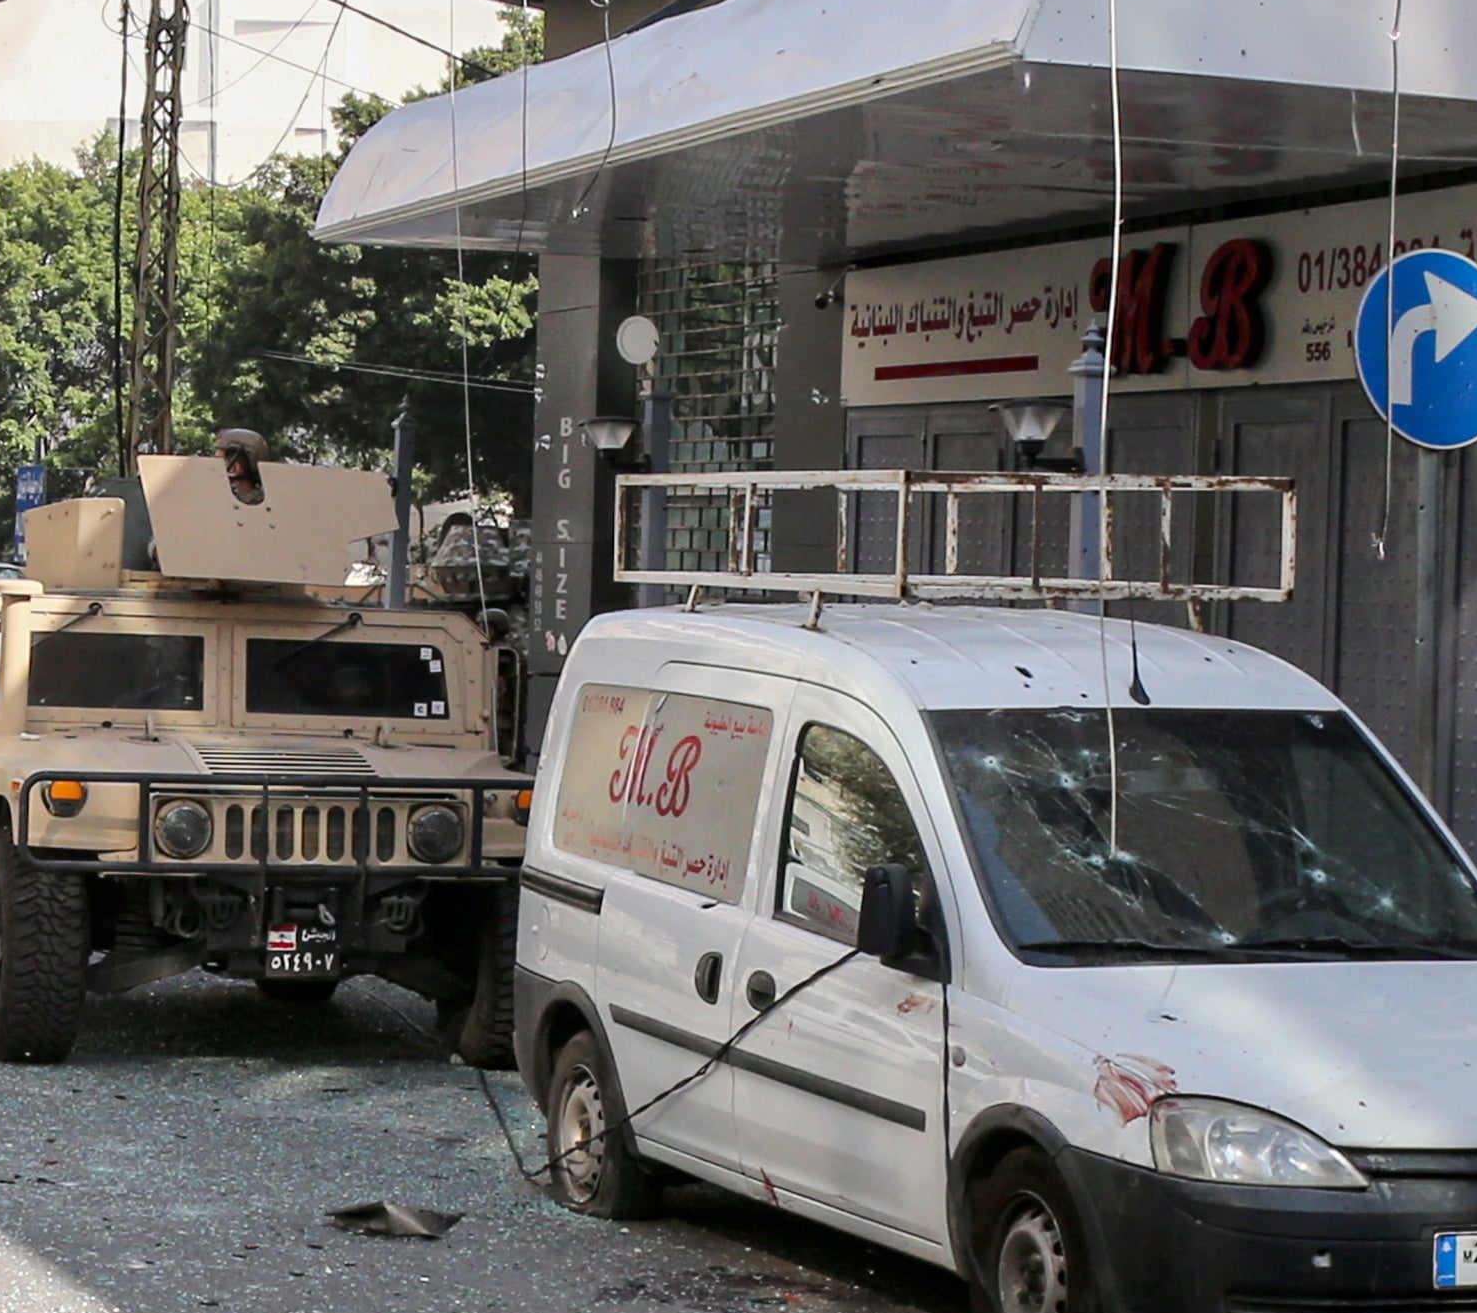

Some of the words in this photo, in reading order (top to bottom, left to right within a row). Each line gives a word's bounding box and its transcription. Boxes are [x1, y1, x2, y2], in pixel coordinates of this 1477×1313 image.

[850, 302, 904, 348] اللبنانية
[906, 296, 964, 343] والتنباك
[967, 290, 1004, 343] التبغ
[1005, 295, 1042, 335] حصر
[1045, 281, 1078, 331] إدارة
[1306, 341, 1331, 363] 556
[558, 416, 573, 489] BIG
[555, 518, 570, 621] SIZE
[301, 928, 336, 942] الجيش
[271, 952, 335, 972] ٥٢٤٩٠٧
